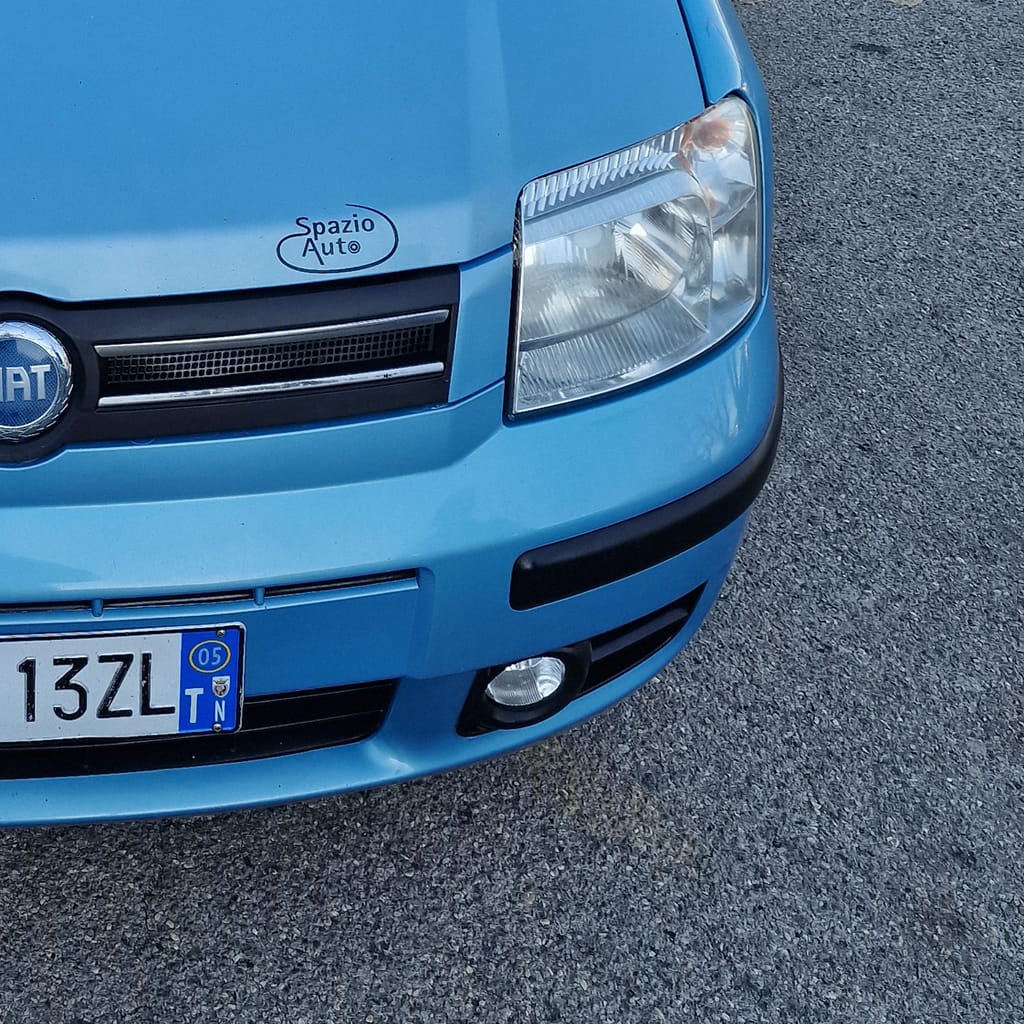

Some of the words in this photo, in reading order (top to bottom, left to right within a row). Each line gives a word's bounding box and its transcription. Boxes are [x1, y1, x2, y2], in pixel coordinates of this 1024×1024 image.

[295, 214, 375, 241] Spazio
[301, 237, 361, 266] Auto
[197, 646, 223, 666] 05
